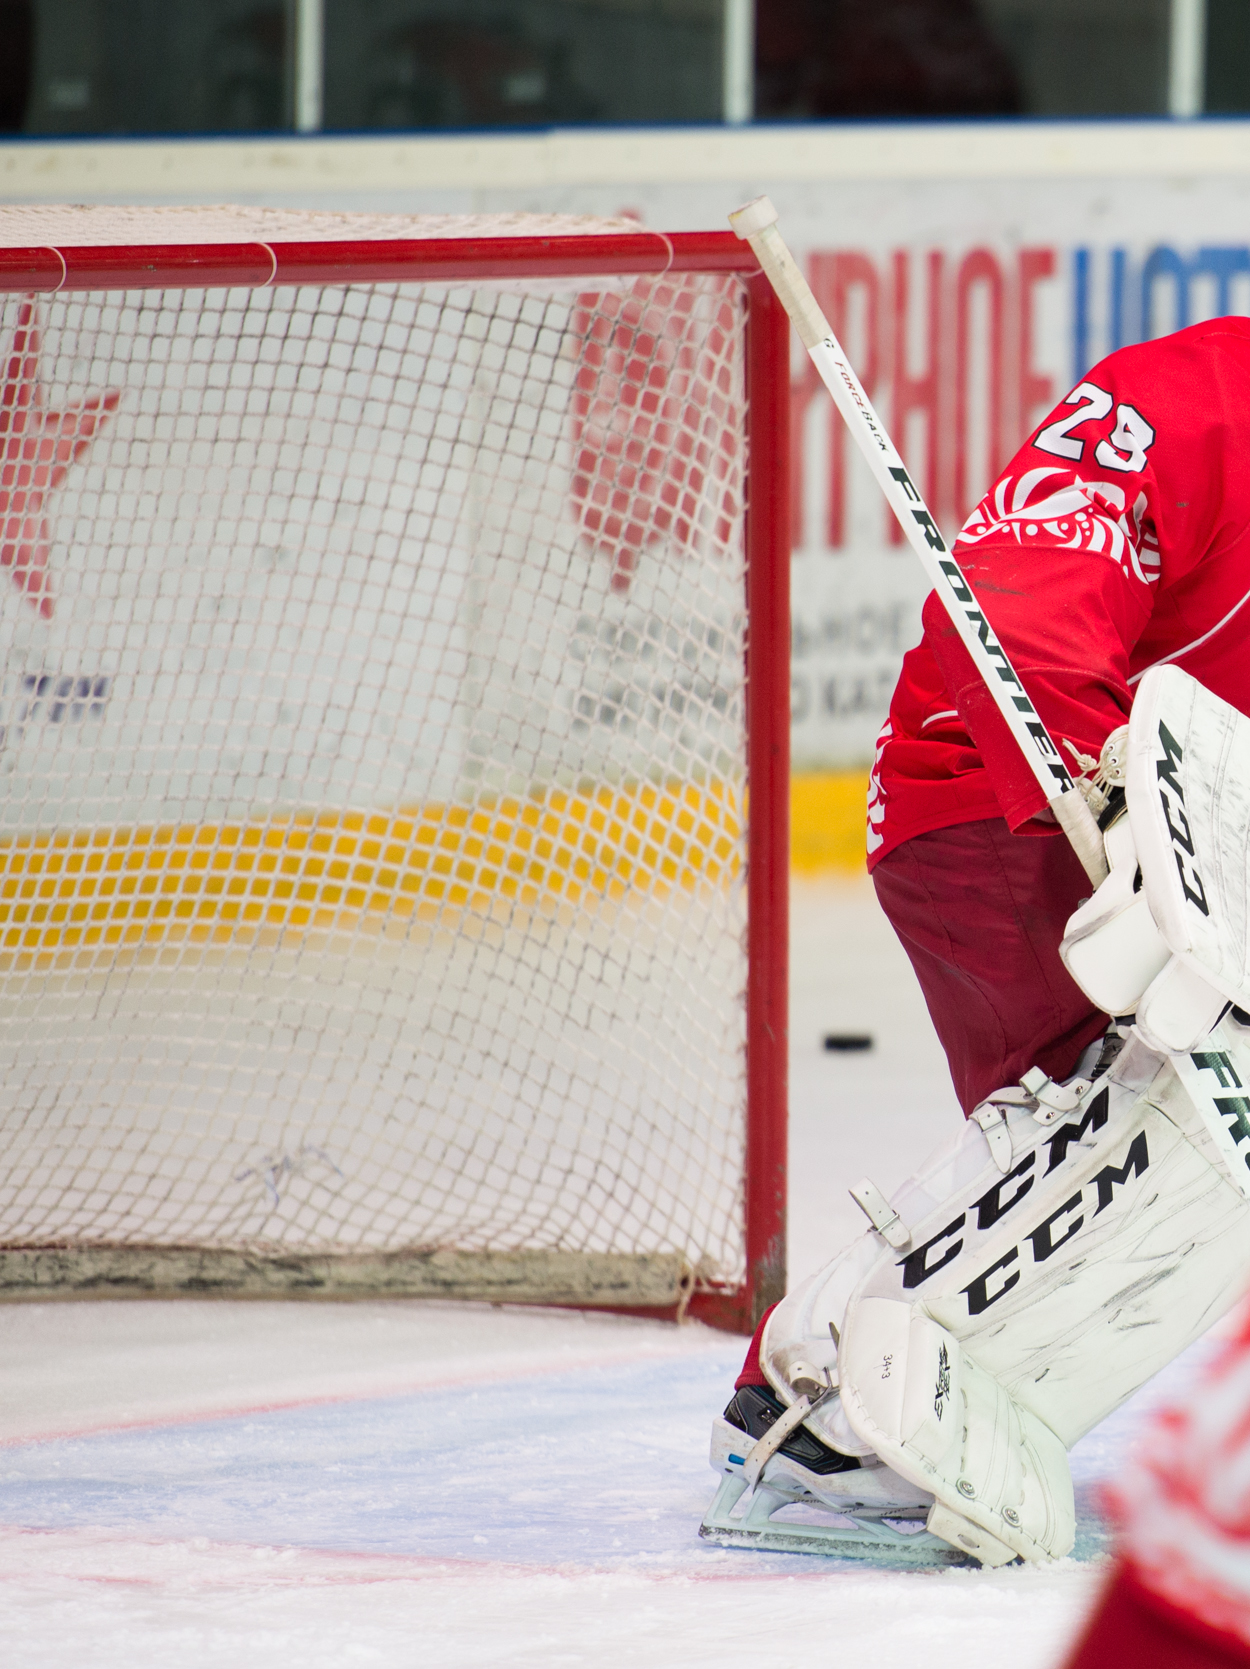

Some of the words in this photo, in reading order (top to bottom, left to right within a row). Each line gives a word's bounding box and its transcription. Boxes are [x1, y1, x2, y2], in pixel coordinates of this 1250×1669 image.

[834, 360, 889, 453] FORCEBACK
[1031, 381, 1157, 474] 29
[1156, 718, 1210, 917] CCM
[895, 1085, 1109, 1289] CCM
[957, 1129, 1150, 1316] CCM
